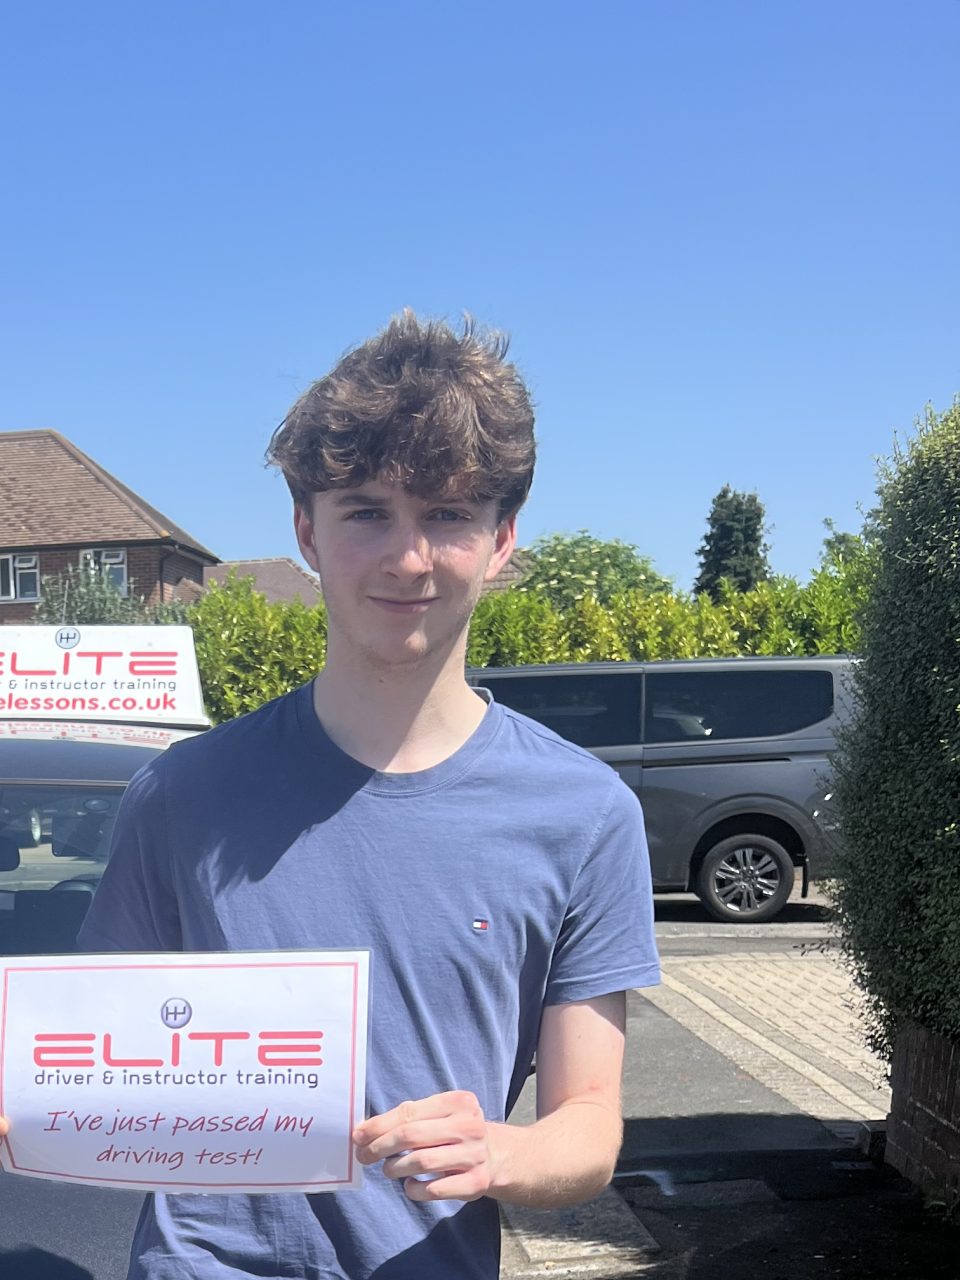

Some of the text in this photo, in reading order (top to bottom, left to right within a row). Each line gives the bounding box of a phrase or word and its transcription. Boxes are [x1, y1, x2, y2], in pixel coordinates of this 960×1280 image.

[8, 679, 18, 690] &
[24, 678, 106, 690] instructor
[113, 678, 176, 692] training
[33, 1030, 324, 1067] ELITE
[34, 1068, 318, 1088] driver & instructor training
[43, 1107, 313, 1137] I've just passed my
[96, 1144, 263, 1171] driving test!
